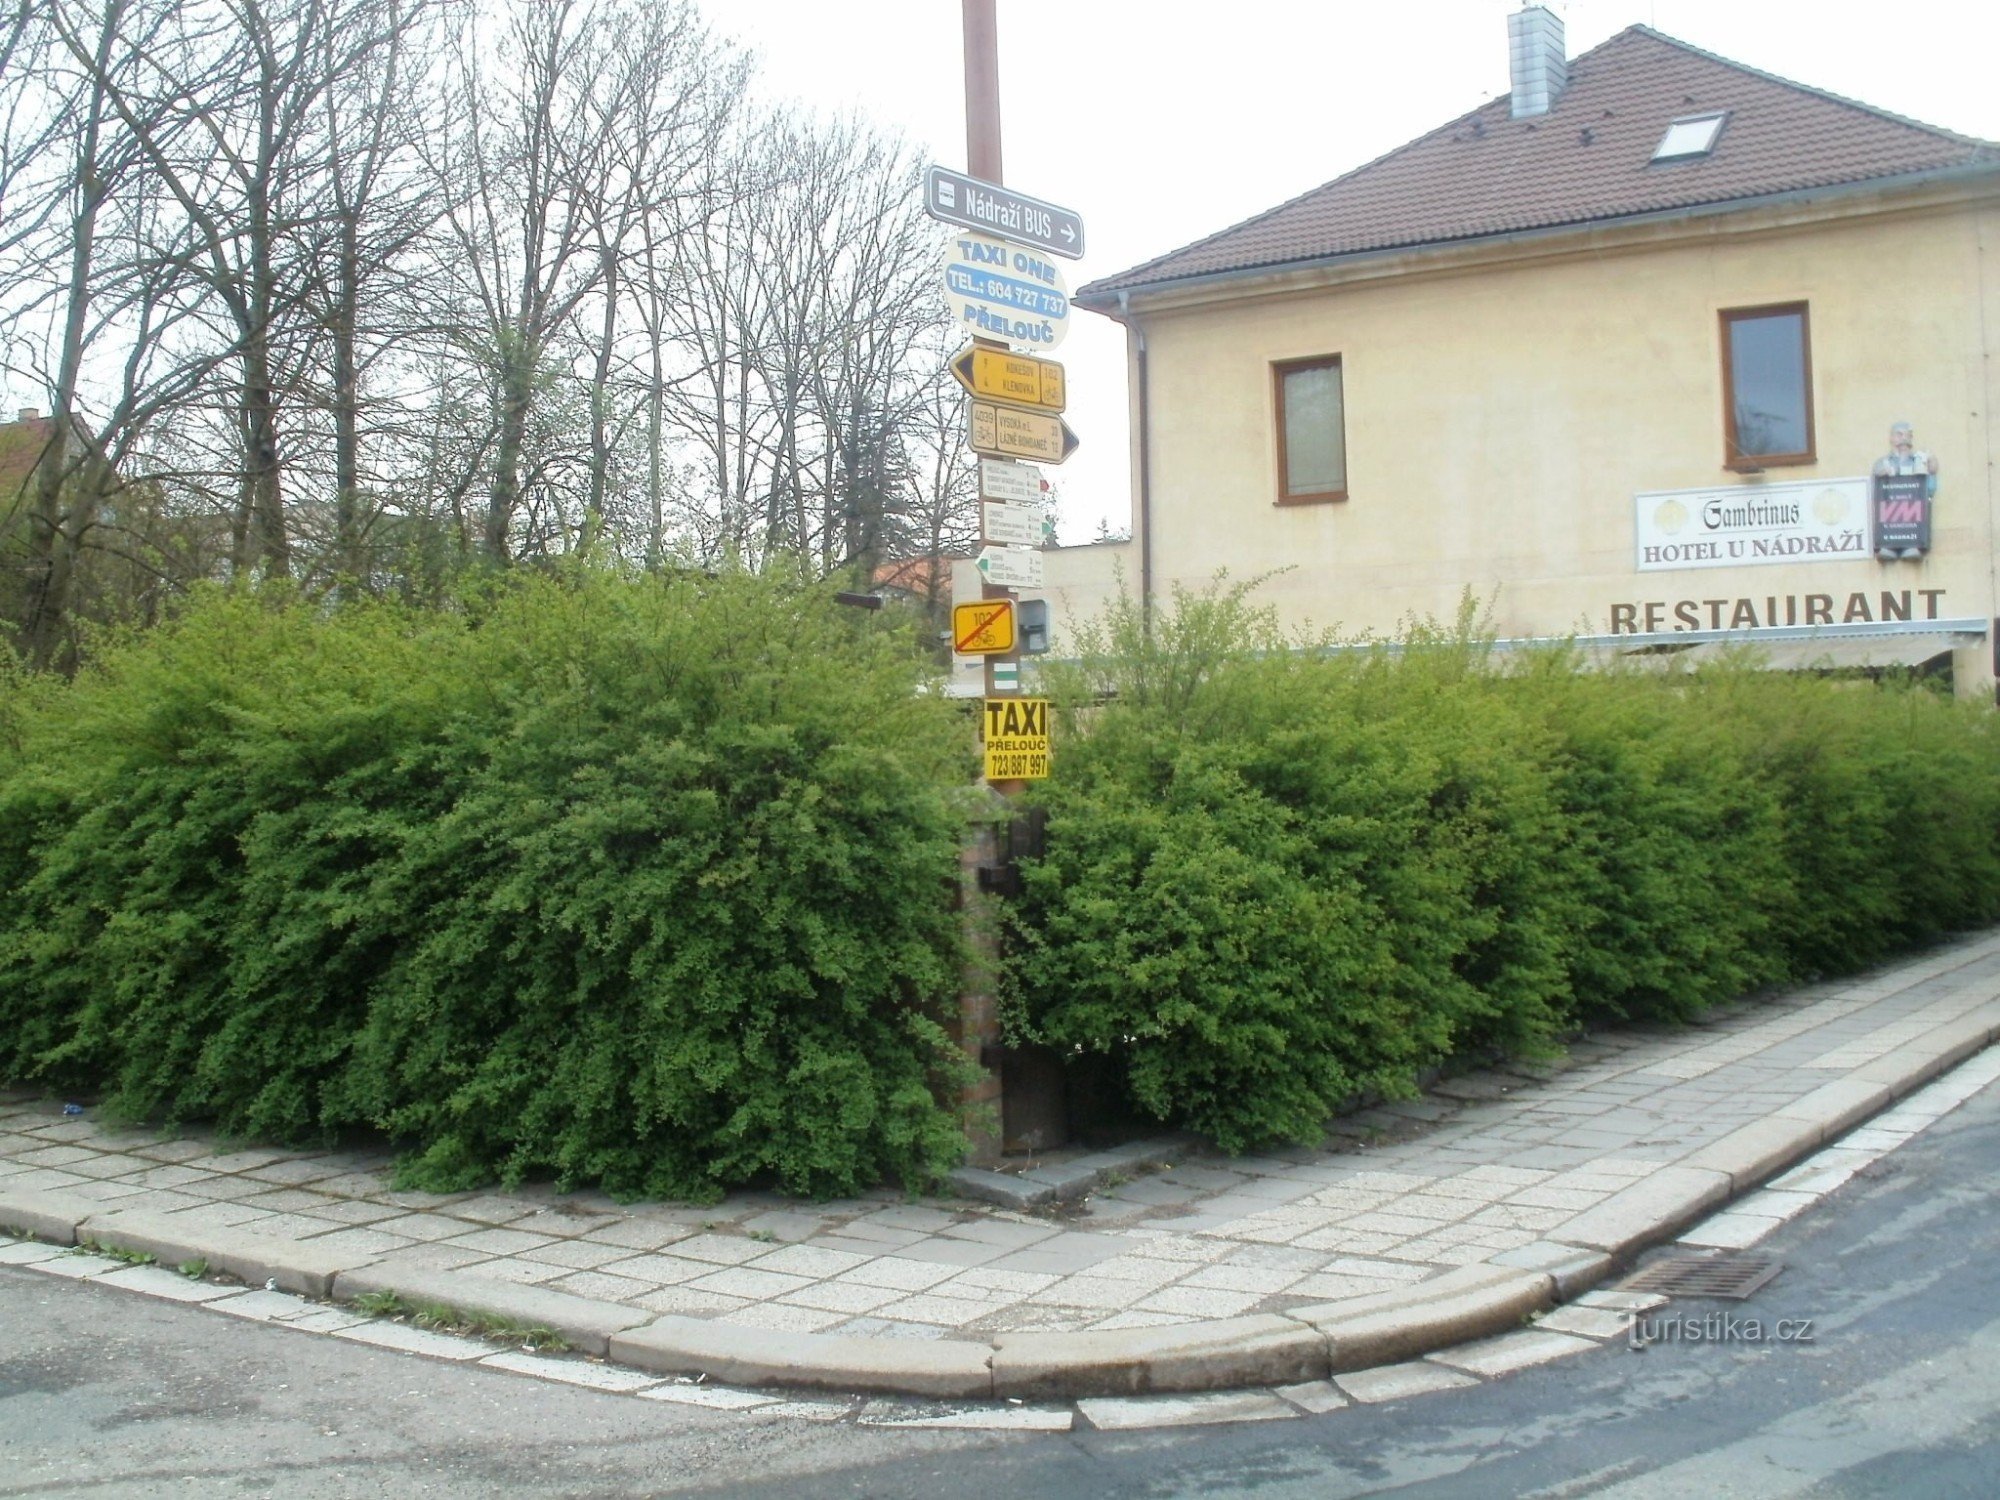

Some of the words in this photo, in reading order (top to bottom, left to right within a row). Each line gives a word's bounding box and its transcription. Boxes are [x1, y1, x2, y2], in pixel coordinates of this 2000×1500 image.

[966, 188, 1021, 229] Nádraží
[1025, 208, 1052, 239] BUS
[957, 240, 1007, 267] TAXI
[1013, 253, 1056, 285] ONE
[949, 270, 984, 293] TEL.:
[987, 280, 1012, 300] 604
[1015, 286, 1039, 306] 727
[1042, 292, 1065, 314] 737
[963, 304, 1055, 343] PŘELOUČ
[1044, 367, 1058, 380] 102
[974, 410, 994, 424] 4039
[1702, 499, 1800, 530] Gambrinus
[1643, 542, 1723, 564] HOTEL
[1728, 541, 1746, 558] U
[1752, 529, 1865, 557] NÁDRAŽÍ
[1610, 589, 1946, 635] RESTAURANT
[986, 701, 1046, 737] TAXI
[986, 739, 1046, 752] PŘELOUČ
[991, 755, 1009, 776] 723
[1011, 754, 1028, 776] 887
[1029, 753, 1046, 776] 997
